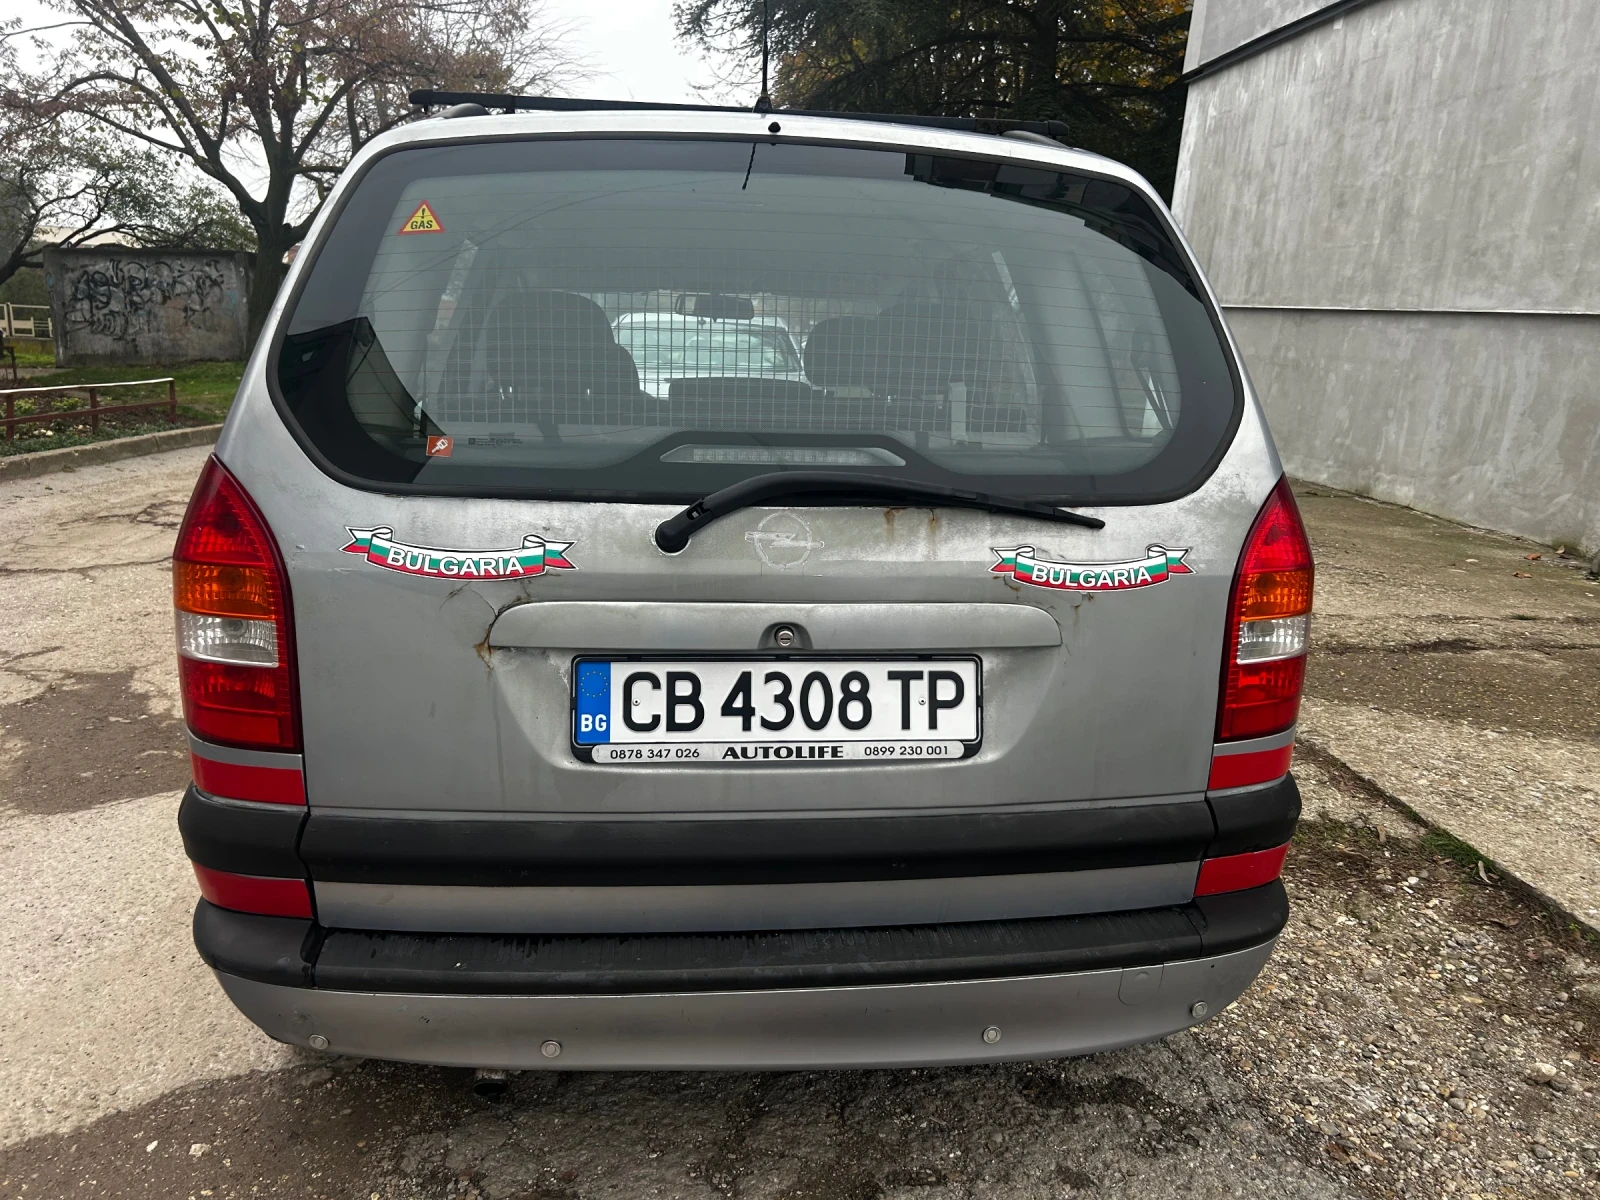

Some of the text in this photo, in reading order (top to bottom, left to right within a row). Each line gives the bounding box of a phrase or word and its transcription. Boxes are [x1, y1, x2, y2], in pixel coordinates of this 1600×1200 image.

[410, 219, 433, 229] GAS
[386, 547, 525, 576] BULGARIA
[1031, 564, 1152, 587] BULGARIA
[623, 670, 964, 732] CB 4308 TP
[581, 714, 607, 732] BG
[610, 748, 700, 760] 0878 347 026
[721, 745, 844, 760] AUTOLIFE
[864, 745, 949, 756] 0899 230 001
